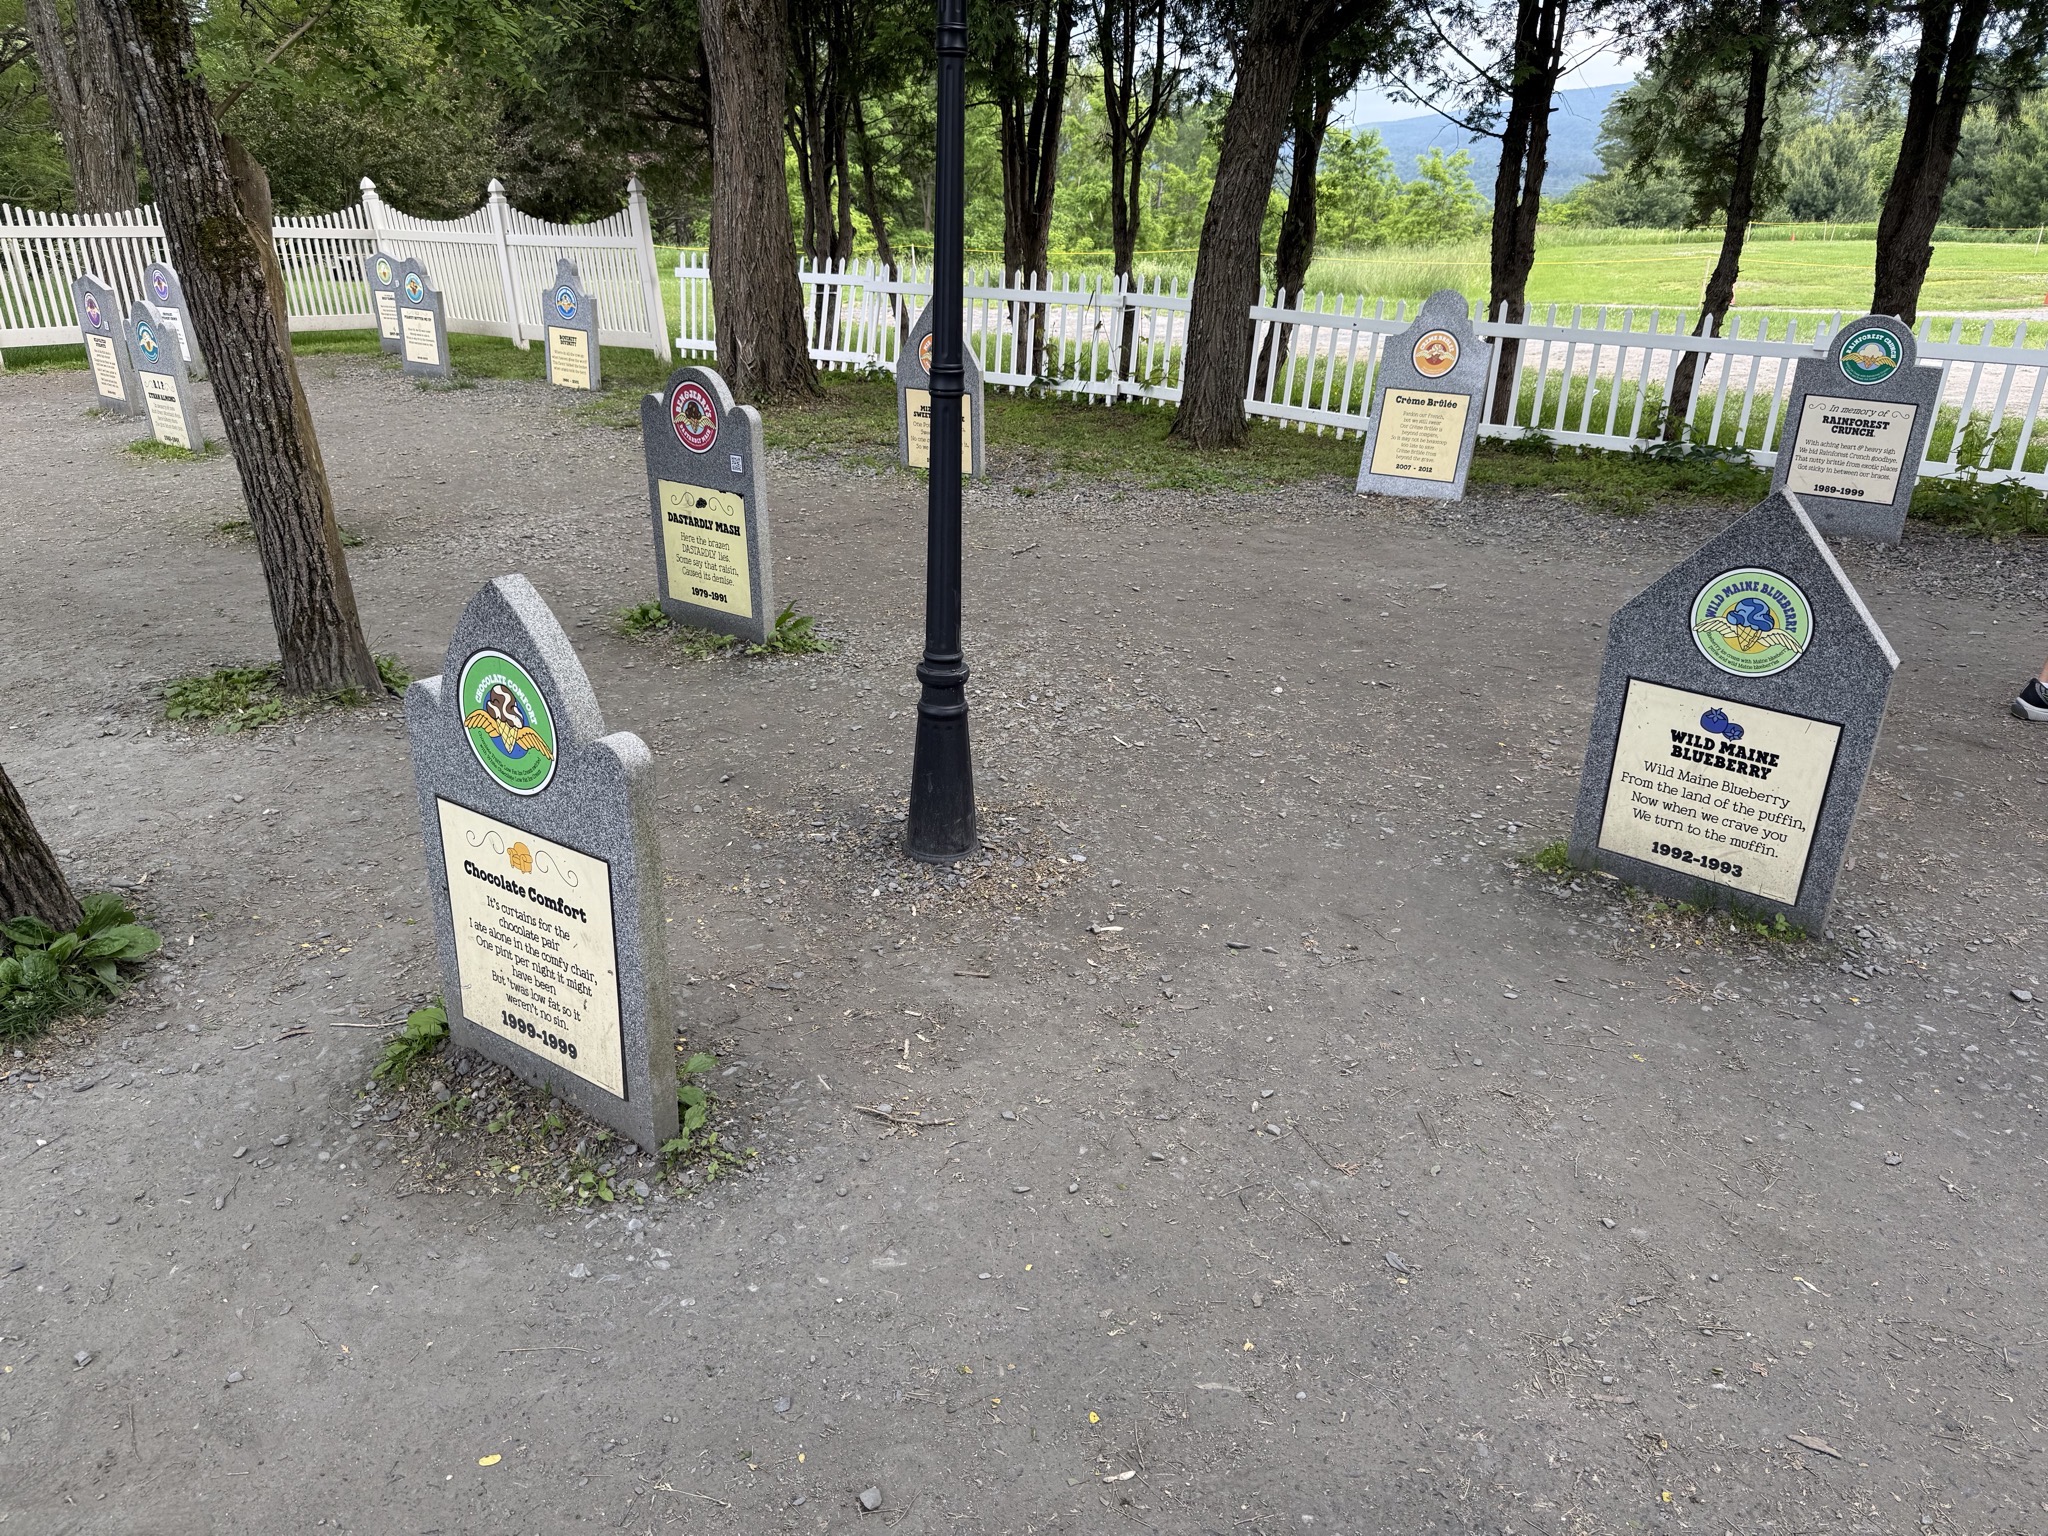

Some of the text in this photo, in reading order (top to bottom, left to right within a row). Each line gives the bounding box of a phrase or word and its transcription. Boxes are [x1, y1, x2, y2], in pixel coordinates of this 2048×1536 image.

[1846, 334, 1896, 359] RAINFOREST CRUNCH
[1822, 415, 1890, 430] RAINFOREST
[1840, 408, 1877, 417] memory
[1814, 484, 1864, 497] 1989-1999
[667, 512, 741, 536] DASTARDLY MASH
[680, 532, 730, 551] Here the brazen
[676, 554, 692, 565] Some
[693, 559, 703, 569] say
[704, 560, 718, 571] that
[682, 544, 716, 559] DASTARDLY
[692, 587, 728, 603] 1979-1991
[1705, 581, 1797, 633] WILD MAINE BLUEBERRY
[475, 674, 538, 725] CHOCOLATE COMFORT
[1670, 745, 1772, 780] BLUEBERRY
[1671, 729, 1780, 767] WILD MAINE
[1621, 771, 1806, 832] From the land of the puffin,
[1644, 761, 1790, 809] Wild Maine Blueberry
[1631, 791, 1788, 843] Now when we crave you
[1633, 808, 1778, 858] We turn to the muffin.
[1652, 842, 1743, 877] 1992-1993
[464, 860, 587, 923] Chocolate Comfort
[487, 895, 570, 941] It's curtains for the
[499, 917, 560, 951] chocolate pair
[469, 917, 597, 986] I ate alone in the comfy chair,
[476, 935, 592, 997] One pint per night it might
[492, 970, 581, 1022] But 'twas low fat so it
[512, 965, 556, 995] have been
[506, 993, 569, 1031] weren't no sin.
[502, 1010, 577, 1059] 1999-1999
